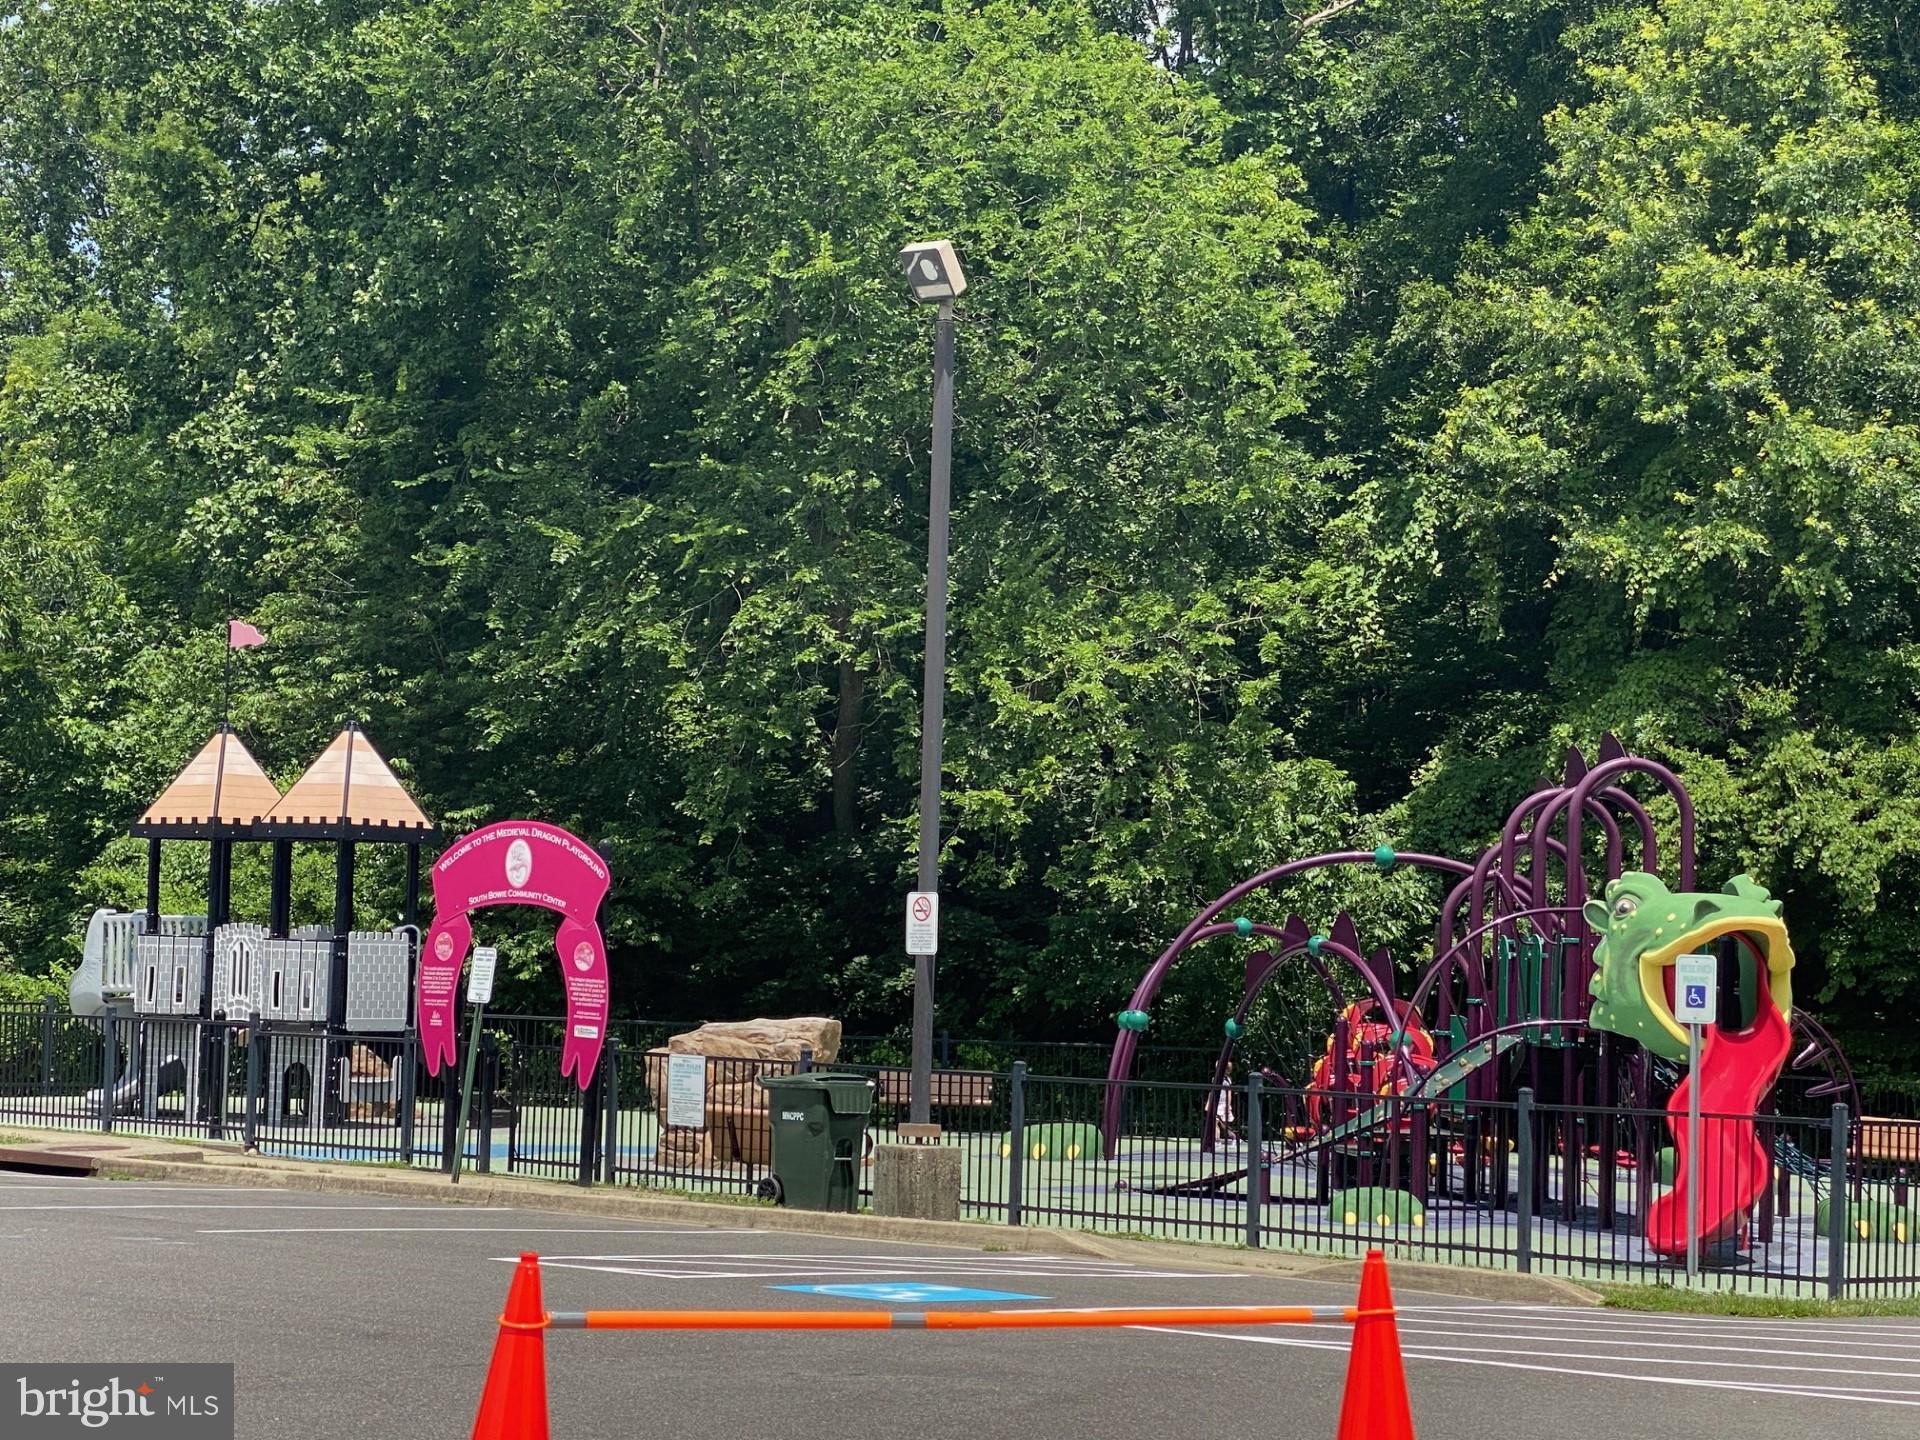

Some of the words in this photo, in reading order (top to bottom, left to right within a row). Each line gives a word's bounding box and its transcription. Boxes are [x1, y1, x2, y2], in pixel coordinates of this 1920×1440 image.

[439, 842, 472, 872] WELCOME
[472, 838, 482, 848] TO
[482, 831, 496, 843] THE
